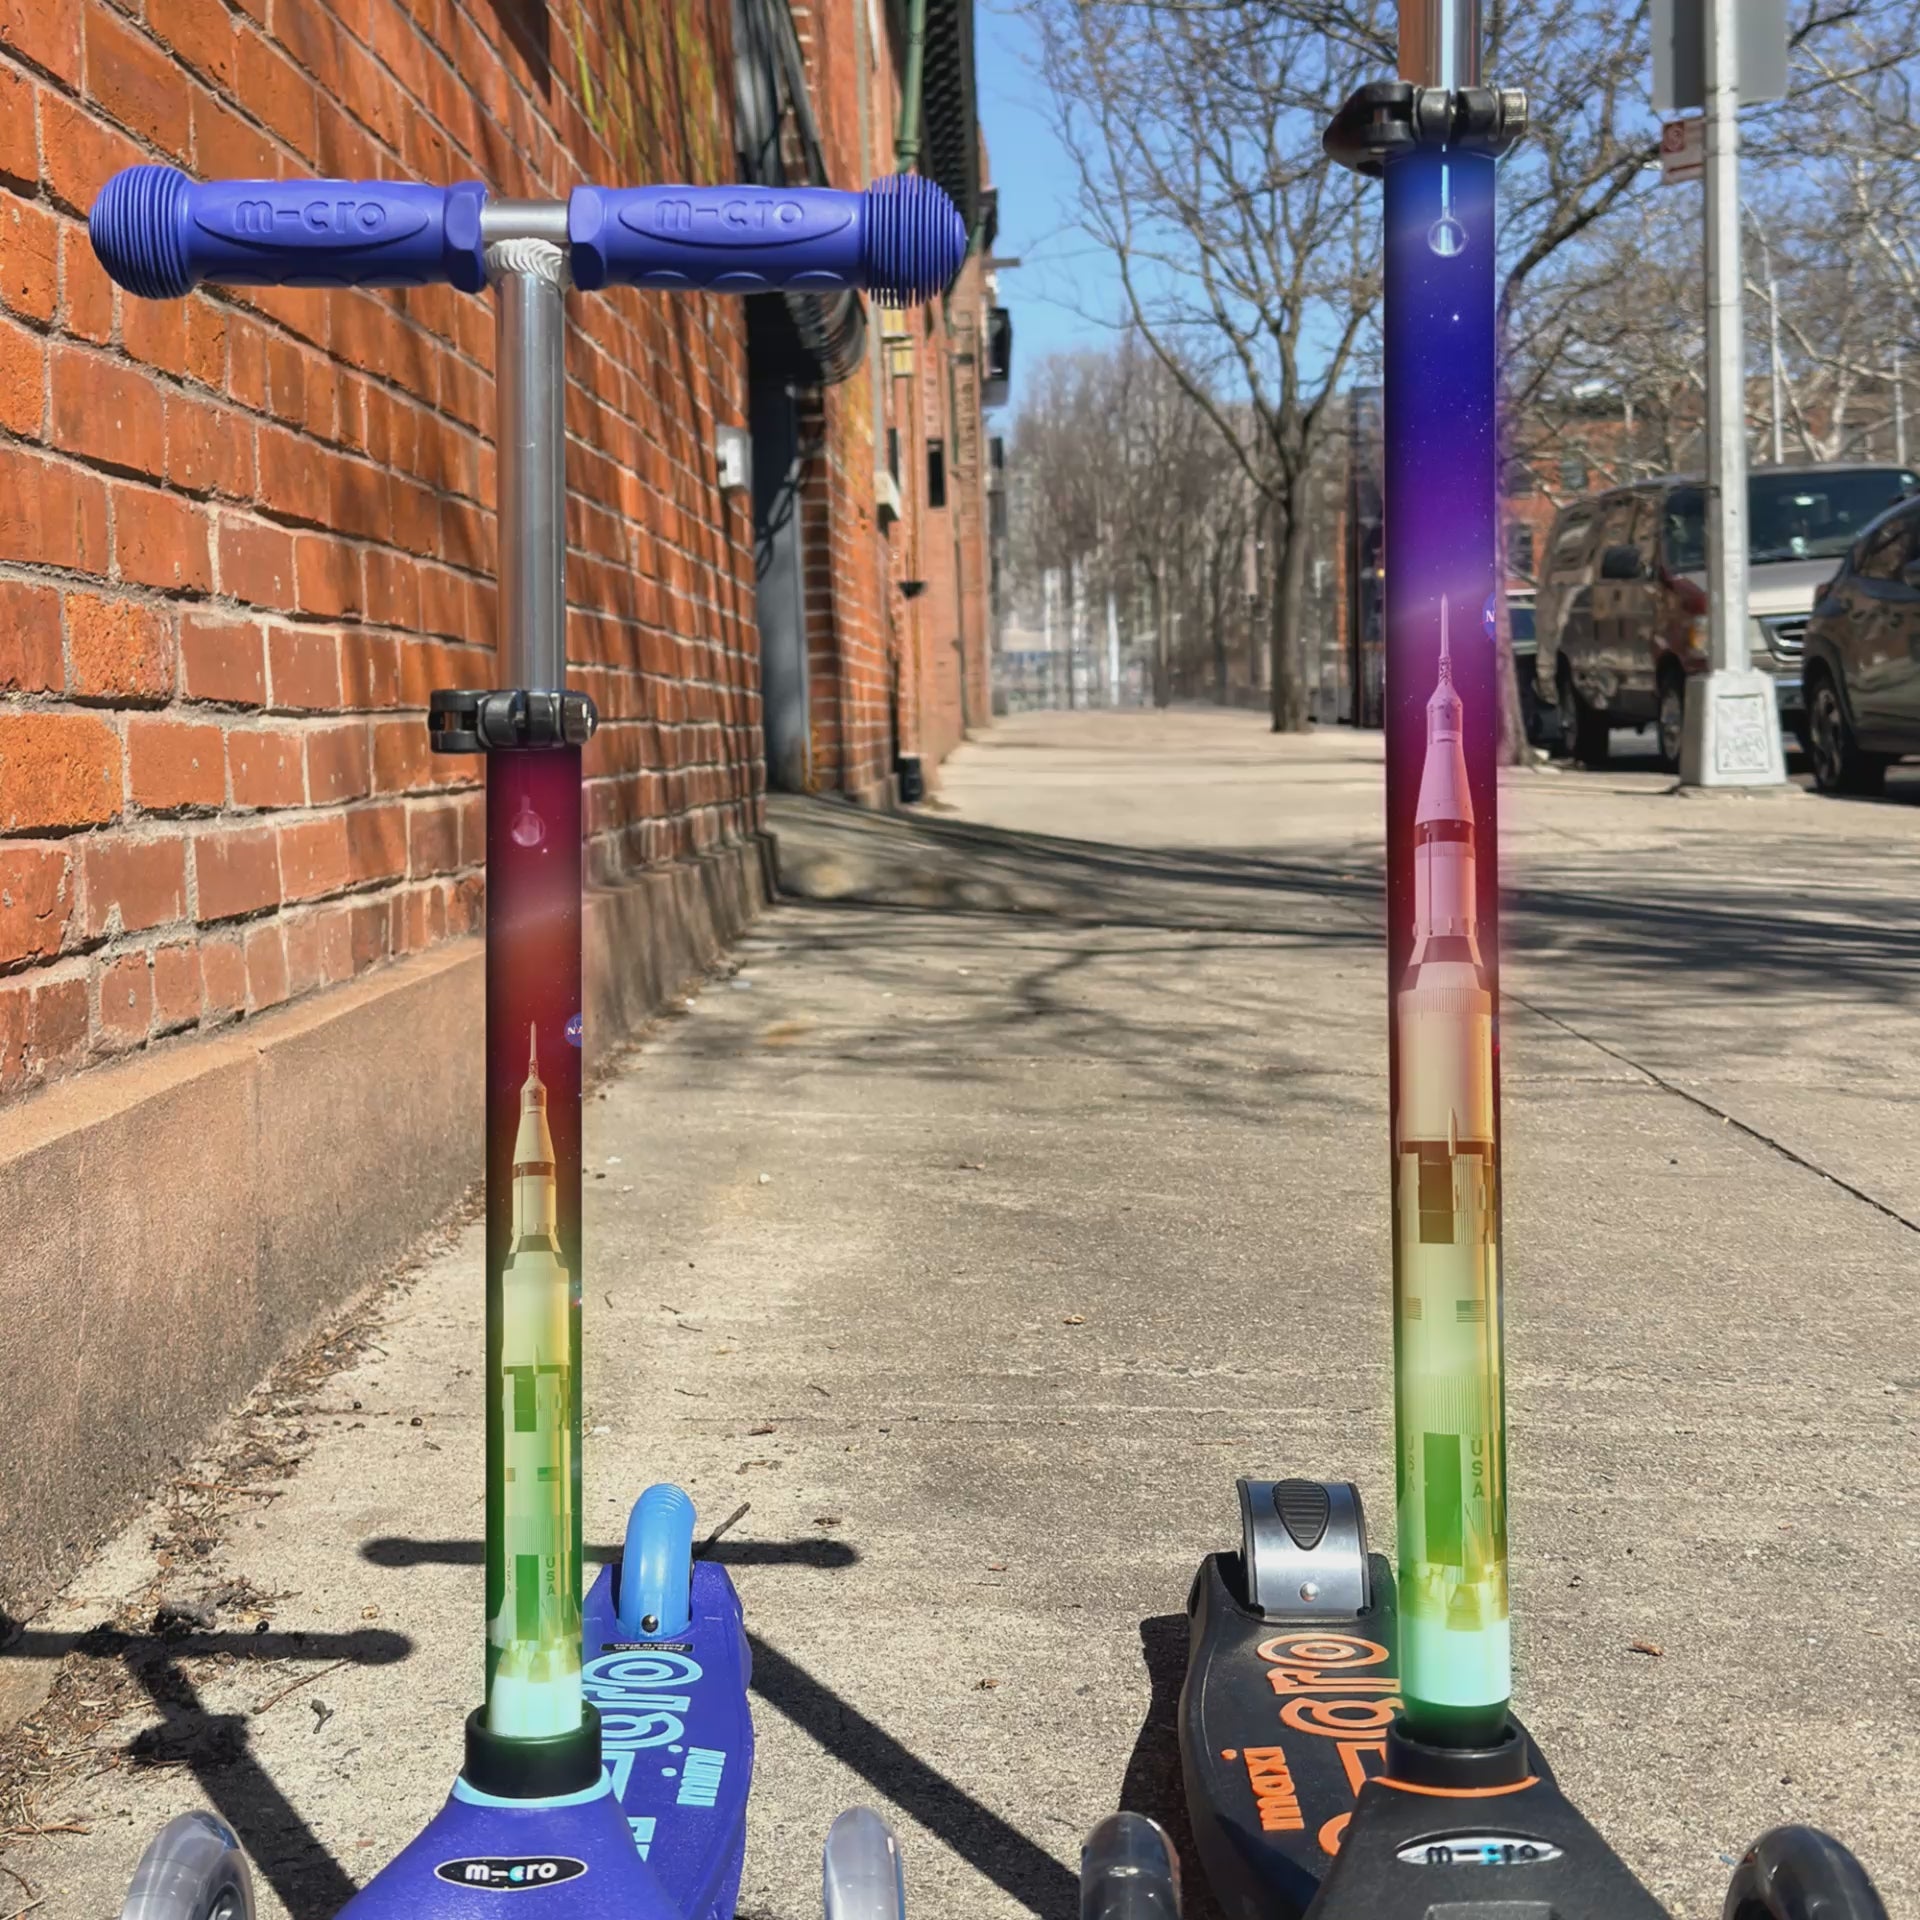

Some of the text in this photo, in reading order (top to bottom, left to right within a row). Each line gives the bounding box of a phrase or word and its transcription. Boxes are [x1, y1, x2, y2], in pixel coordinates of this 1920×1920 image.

[1470, 1439, 1485, 1498] USA
[545, 1556, 557, 1596] USA
[660, 1744, 727, 1807] mini
[1221, 1746, 1305, 1831] maxi
